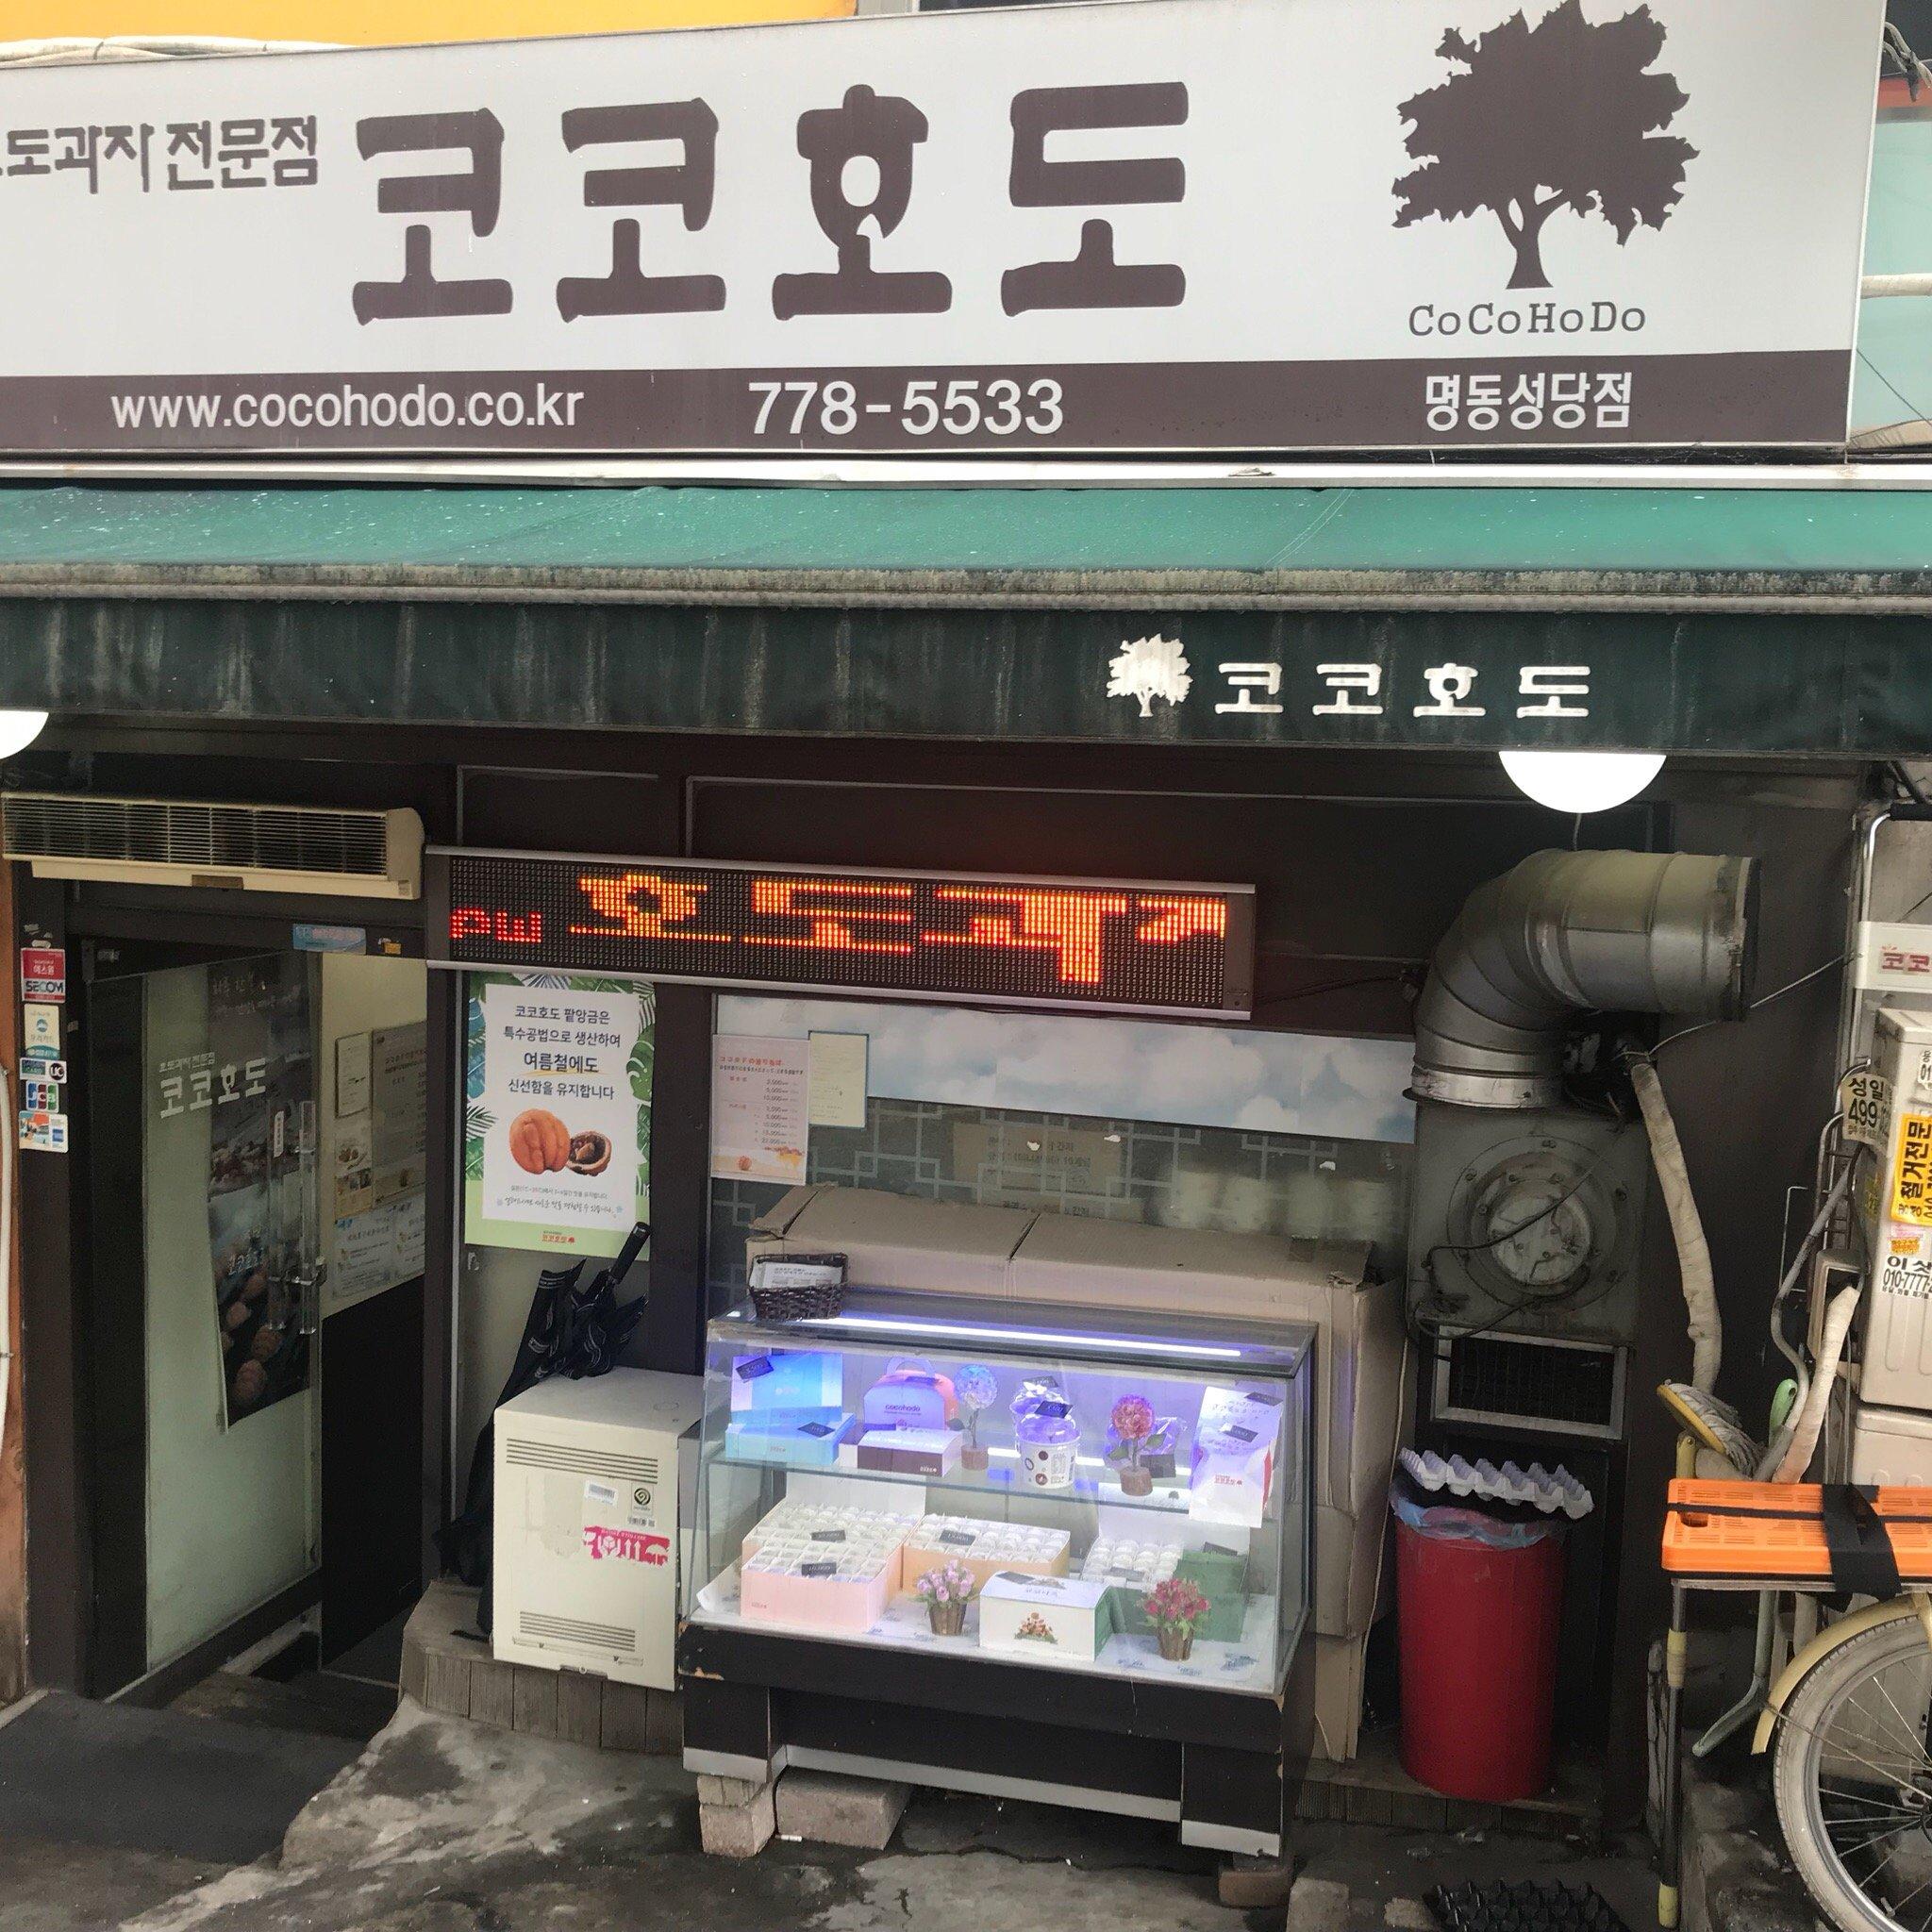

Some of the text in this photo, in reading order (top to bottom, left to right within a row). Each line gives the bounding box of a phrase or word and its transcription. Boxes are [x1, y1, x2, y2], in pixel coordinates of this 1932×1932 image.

[0, 115, 318, 194] 도과자 전문점
[352, 81, 1189, 326] 코코호도
[1408, 302, 1646, 337] CoCoHoDo
[111, 383, 584, 429] www.cocohodo.co.kr
[749, 379, 1064, 435] 778-5533
[1425, 372, 1633, 432] 명동성당점
[1215, 662, 1591, 718] 코코호도
[25, 980, 64, 993] SECOM
[503, 1025, 621, 1047] 특수공법으로 생산하여
[514, 1005, 610, 1025] 코코호도 팥앙금은
[160, 1058, 266, 1119] 코코호도
[508, 1078, 615, 1099] 신선함을 유지합니다
[525, 1052, 600, 1074] 여름철에도
[1900, 1122, 1932, 1200] 철거전문
